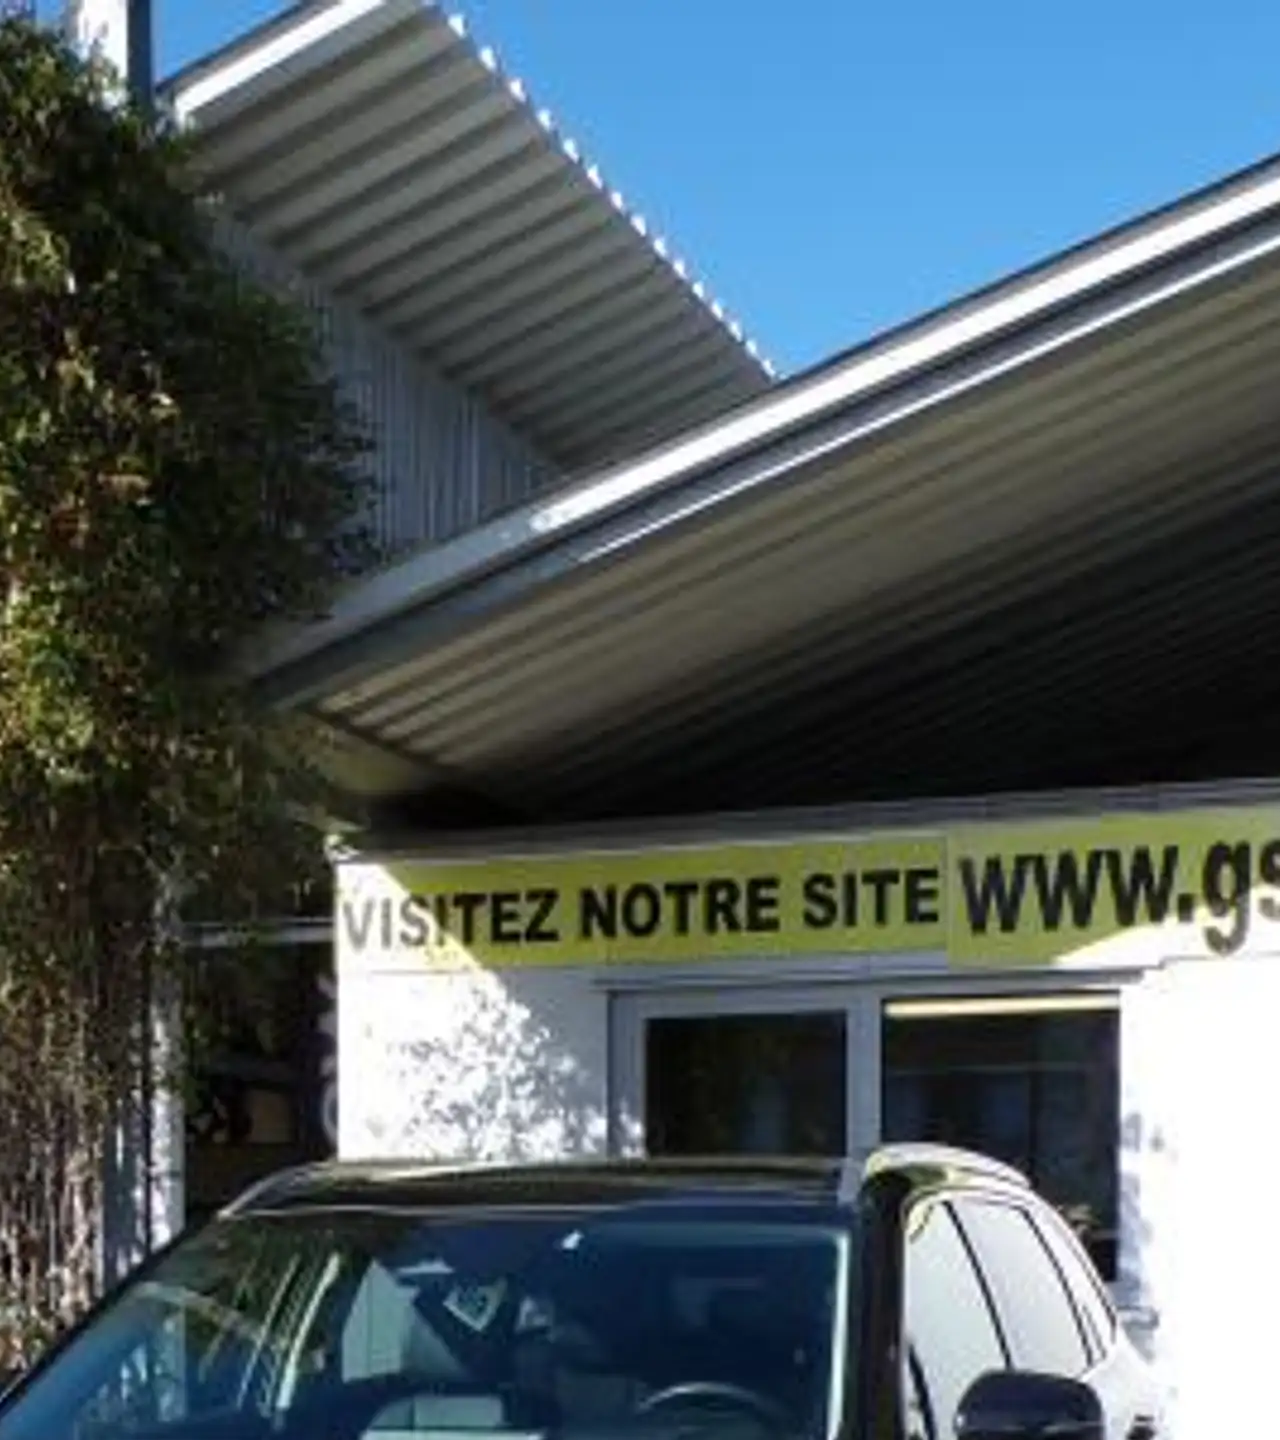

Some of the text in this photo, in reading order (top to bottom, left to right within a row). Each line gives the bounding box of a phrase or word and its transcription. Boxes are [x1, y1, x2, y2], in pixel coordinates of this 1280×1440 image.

[341, 888, 560, 951] VISITEZ
[581, 877, 781, 939] NOTRE
[803, 867, 940, 927] SITE
